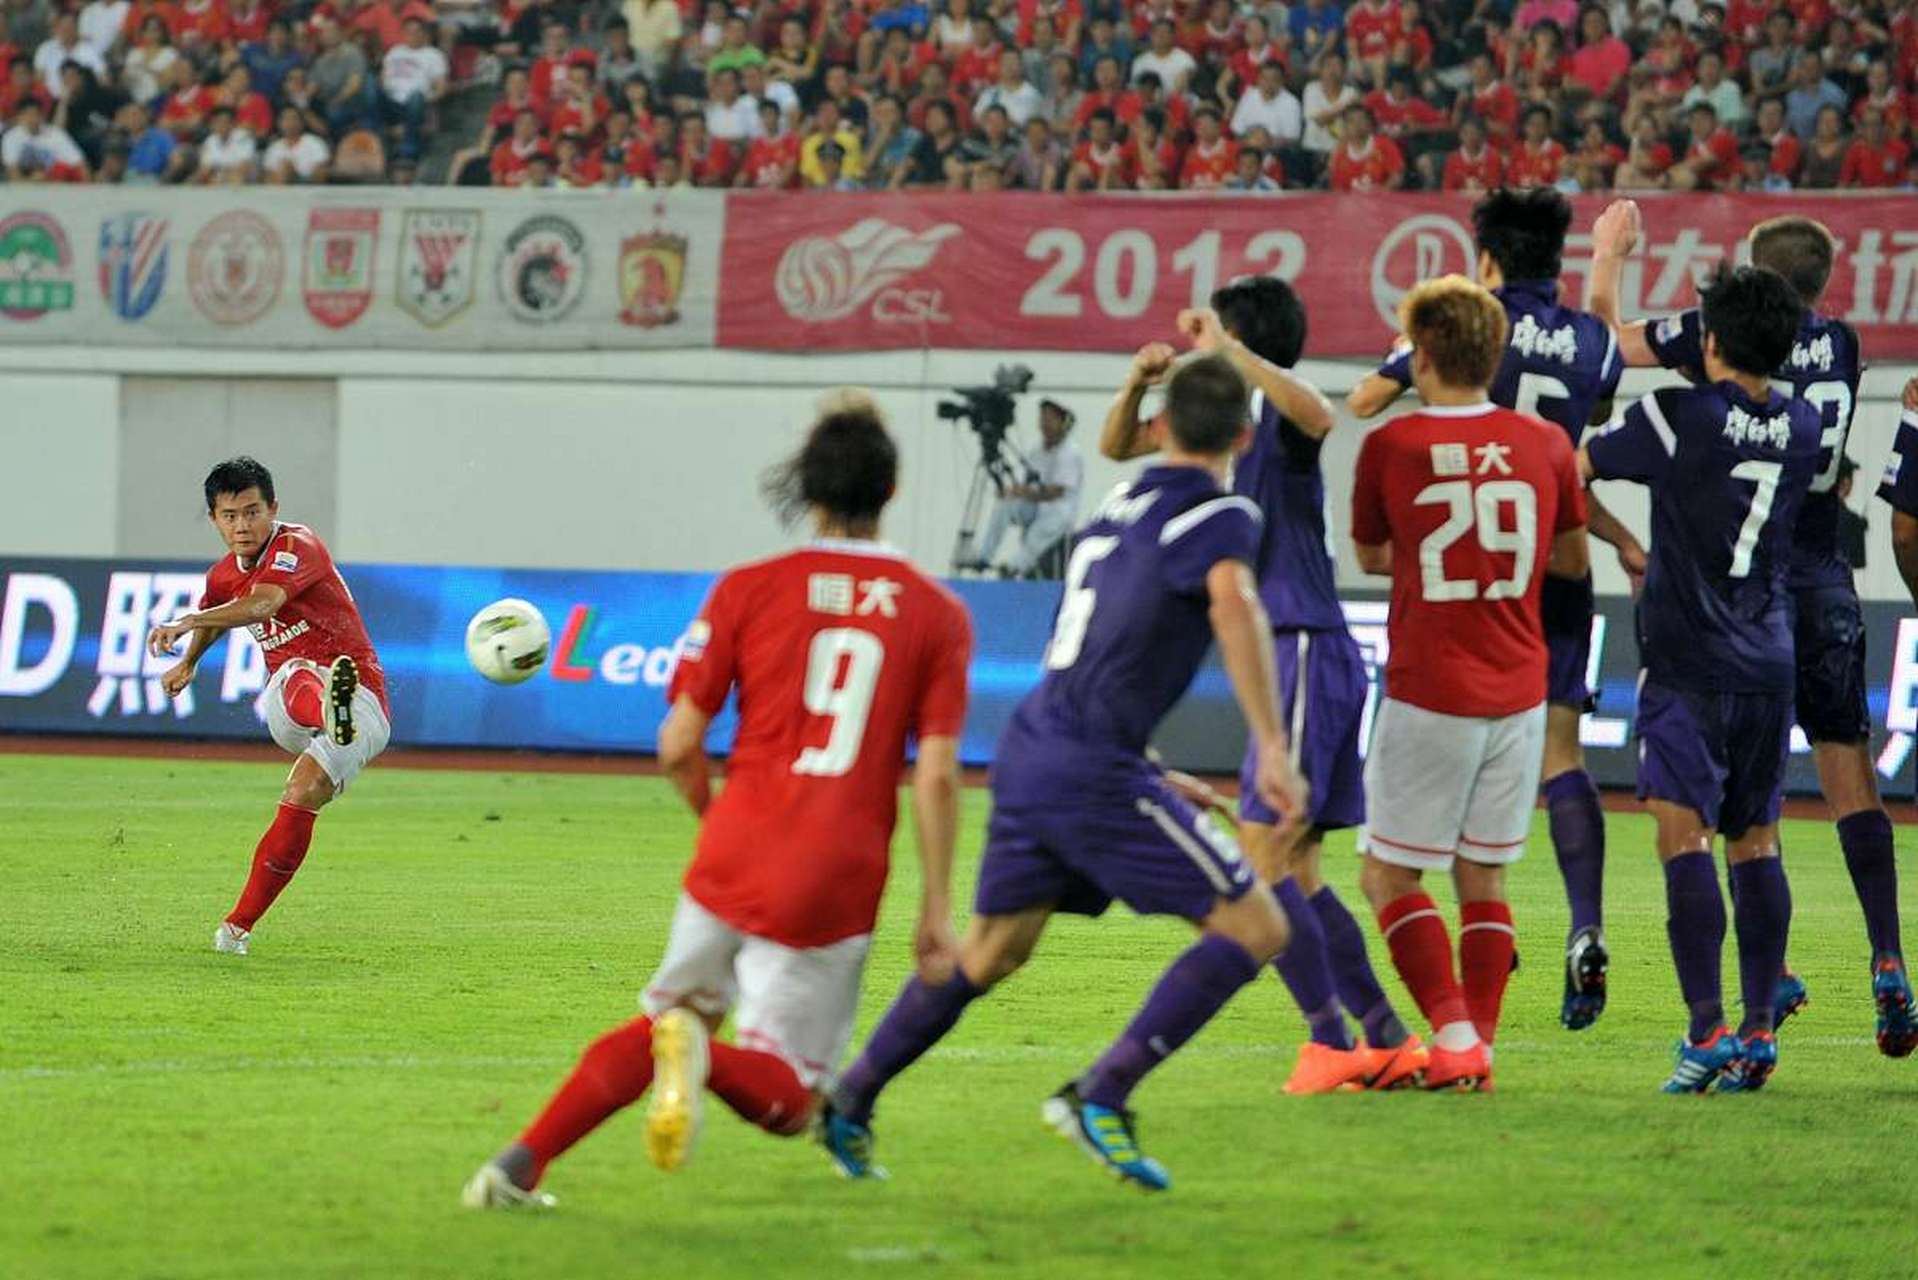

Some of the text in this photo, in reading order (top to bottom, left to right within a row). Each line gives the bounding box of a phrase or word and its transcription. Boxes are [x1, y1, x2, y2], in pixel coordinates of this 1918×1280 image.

[872, 289, 951, 324] CSL
[1430, 442, 1513, 476] 恒大
[1413, 480, 1537, 601] 29
[1728, 460, 1782, 577] 7
[808, 573, 904, 619] 恒大
[792, 626, 885, 777] 9
